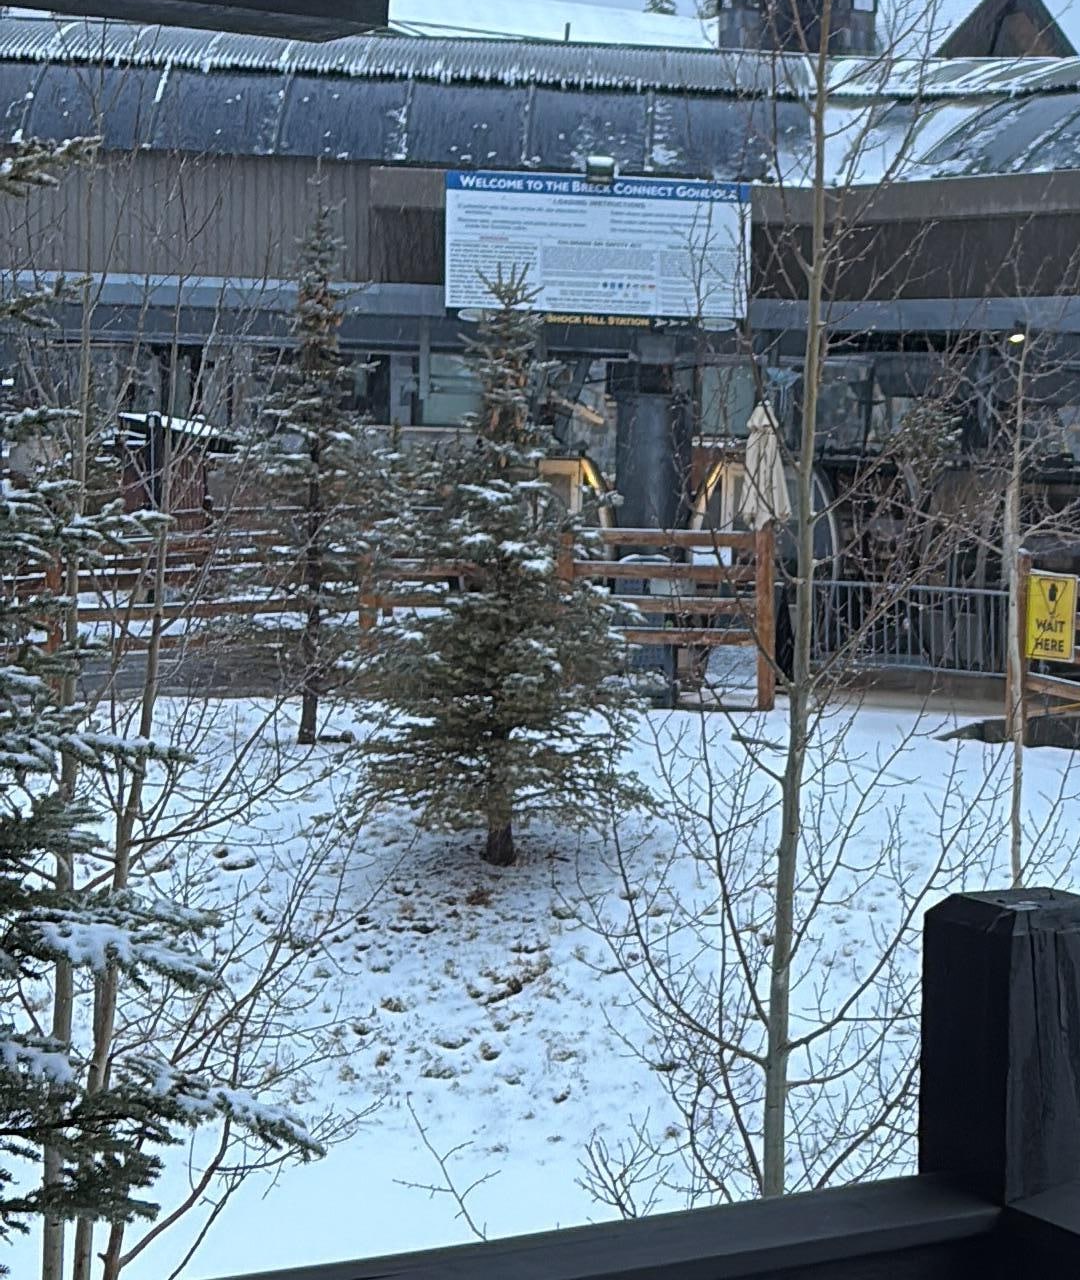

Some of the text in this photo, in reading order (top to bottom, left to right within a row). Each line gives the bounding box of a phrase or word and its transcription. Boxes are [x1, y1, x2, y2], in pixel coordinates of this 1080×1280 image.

[459, 174, 739, 201] WELCOME TO THE BRECK CONNECT GONDOLA
[583, 315, 606, 325] HILL
[607, 316, 650, 326] STATION
[1035, 619, 1066, 633] WAIT
[1035, 638, 1065, 652] HERE
